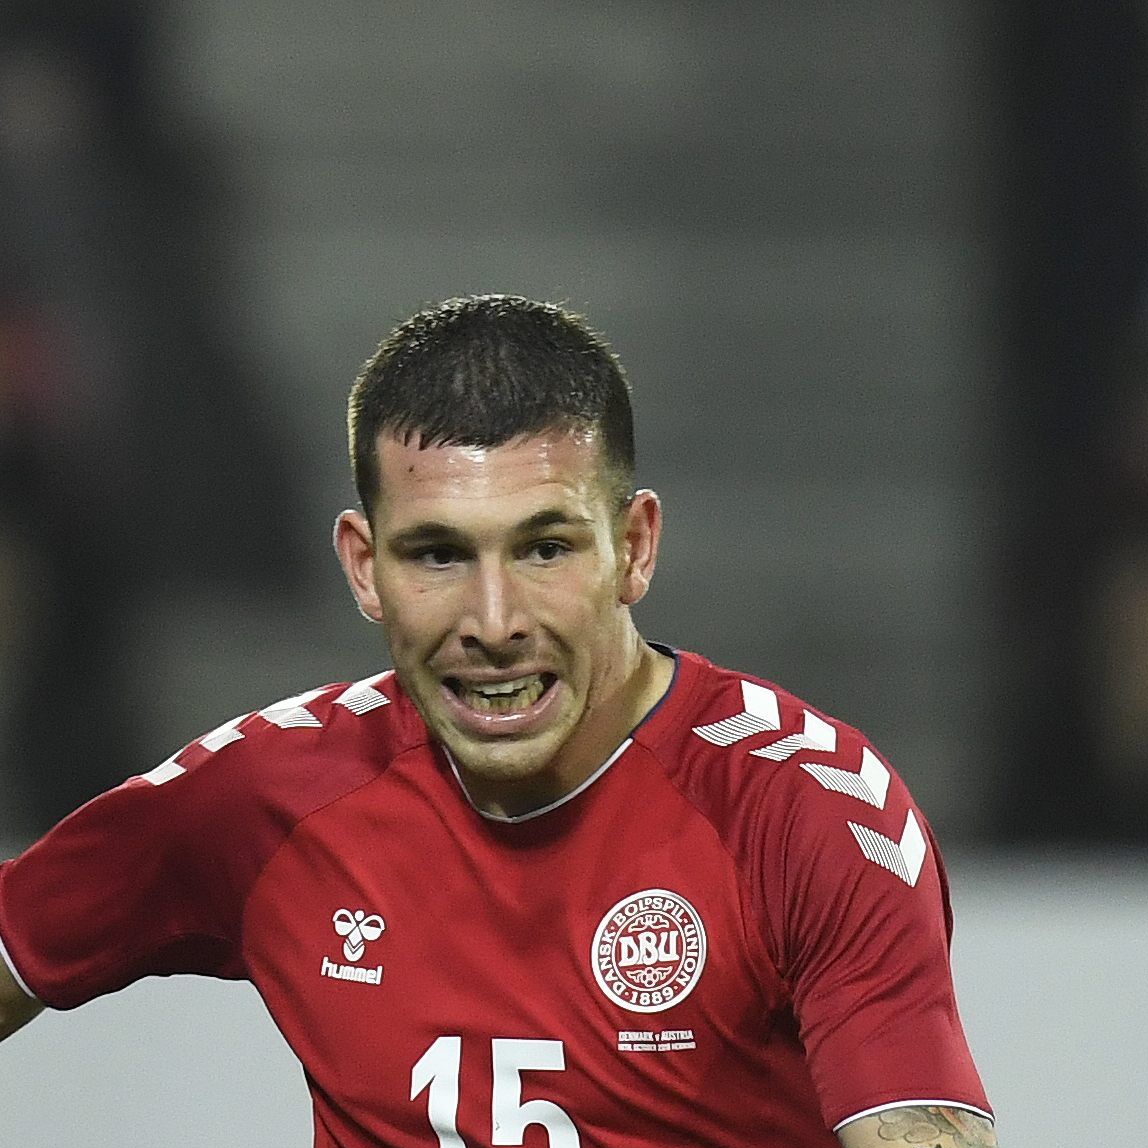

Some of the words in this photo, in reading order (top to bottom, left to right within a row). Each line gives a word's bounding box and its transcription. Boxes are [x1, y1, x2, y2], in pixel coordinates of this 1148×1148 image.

[599, 930, 627, 995] DANSK
[679, 923, 700, 987] UNION
[618, 930, 680, 967] DBU
[321, 956, 383, 985] hummel
[630, 986, 675, 1006] 1889
